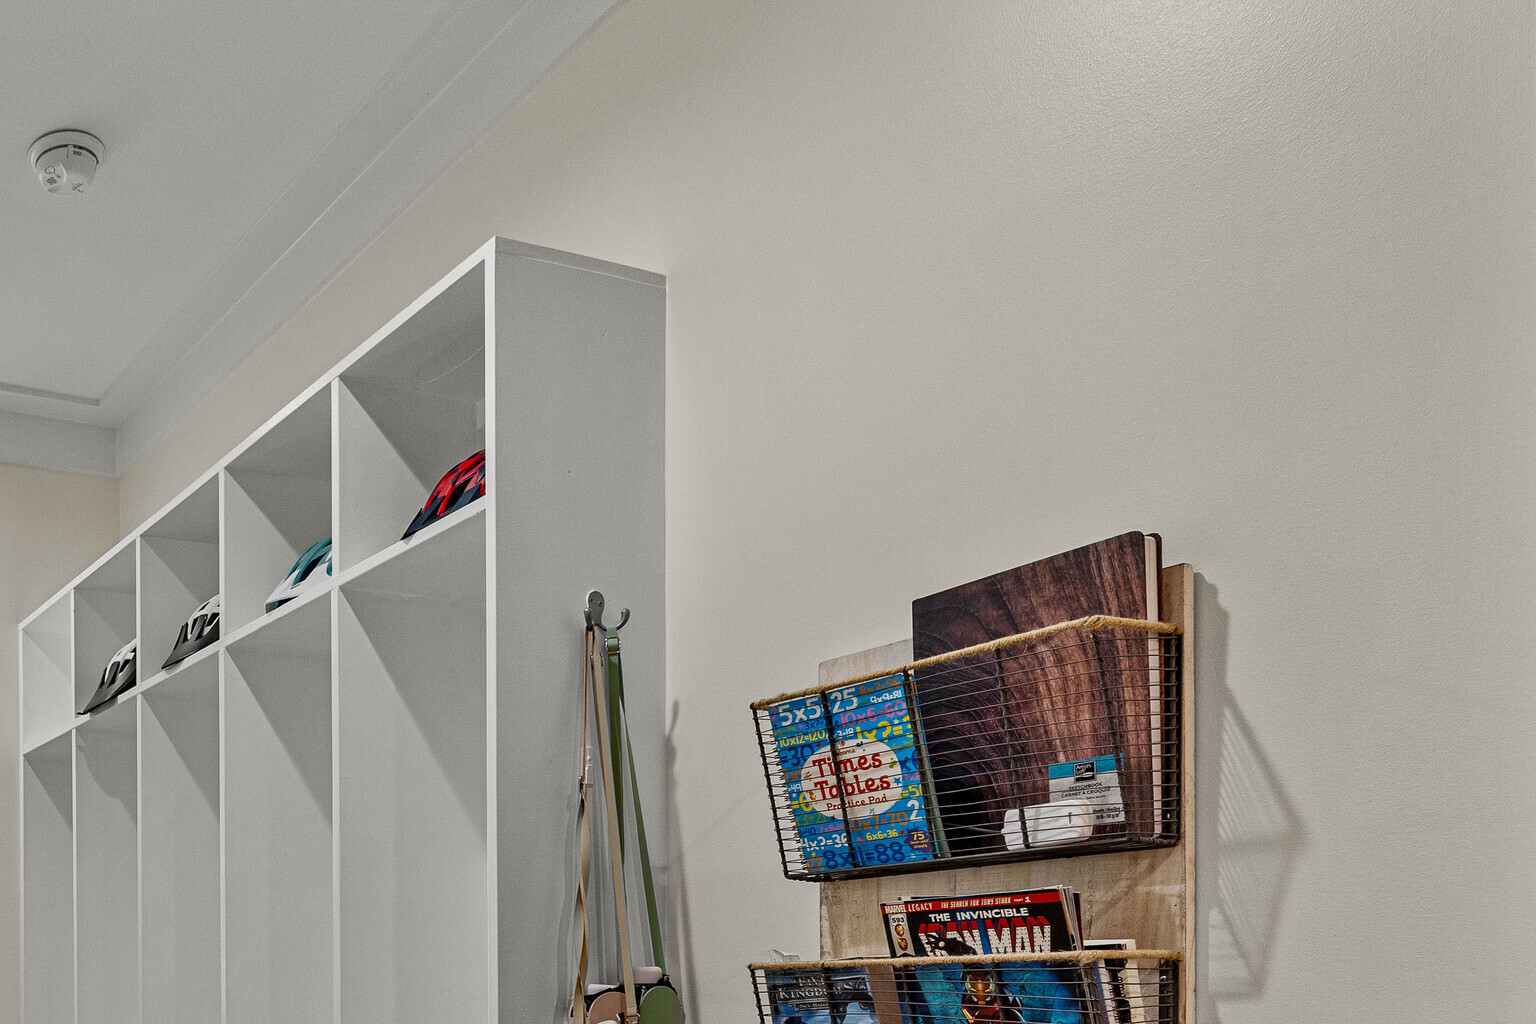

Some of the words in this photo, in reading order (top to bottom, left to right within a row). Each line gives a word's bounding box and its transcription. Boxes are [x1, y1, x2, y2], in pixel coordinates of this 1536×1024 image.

[869, 689, 902, 704] 9x9=81
[839, 700, 906, 729] 10x6=60
[779, 729, 826, 748] 10x12=120
[812, 752, 883, 779] Times
[814, 774, 892, 801] Tables
[1061, 791, 1081, 799] CARNET
[1086, 786, 1112, 795] CROQUIS
[1068, 781, 1103, 791] SKETCHBOOK
[867, 793, 888, 805] Pad
[865, 828, 900, 842] 6x6=36
[913, 831, 926, 842] 75
[884, 904, 908, 914] MARVEL
[908, 902, 934, 912] LEGACY
[940, 901, 950, 909] THE
[950, 900, 969, 909] SEARCH
[981, 898, 995, 906] TONY
[995, 897, 1012, 905] STARK
[891, 916, 905, 925] 593
[928, 911, 952, 923] THE
[956, 907, 1030, 922] INVINCIBLE
[984, 915, 1052, 954] MAN
